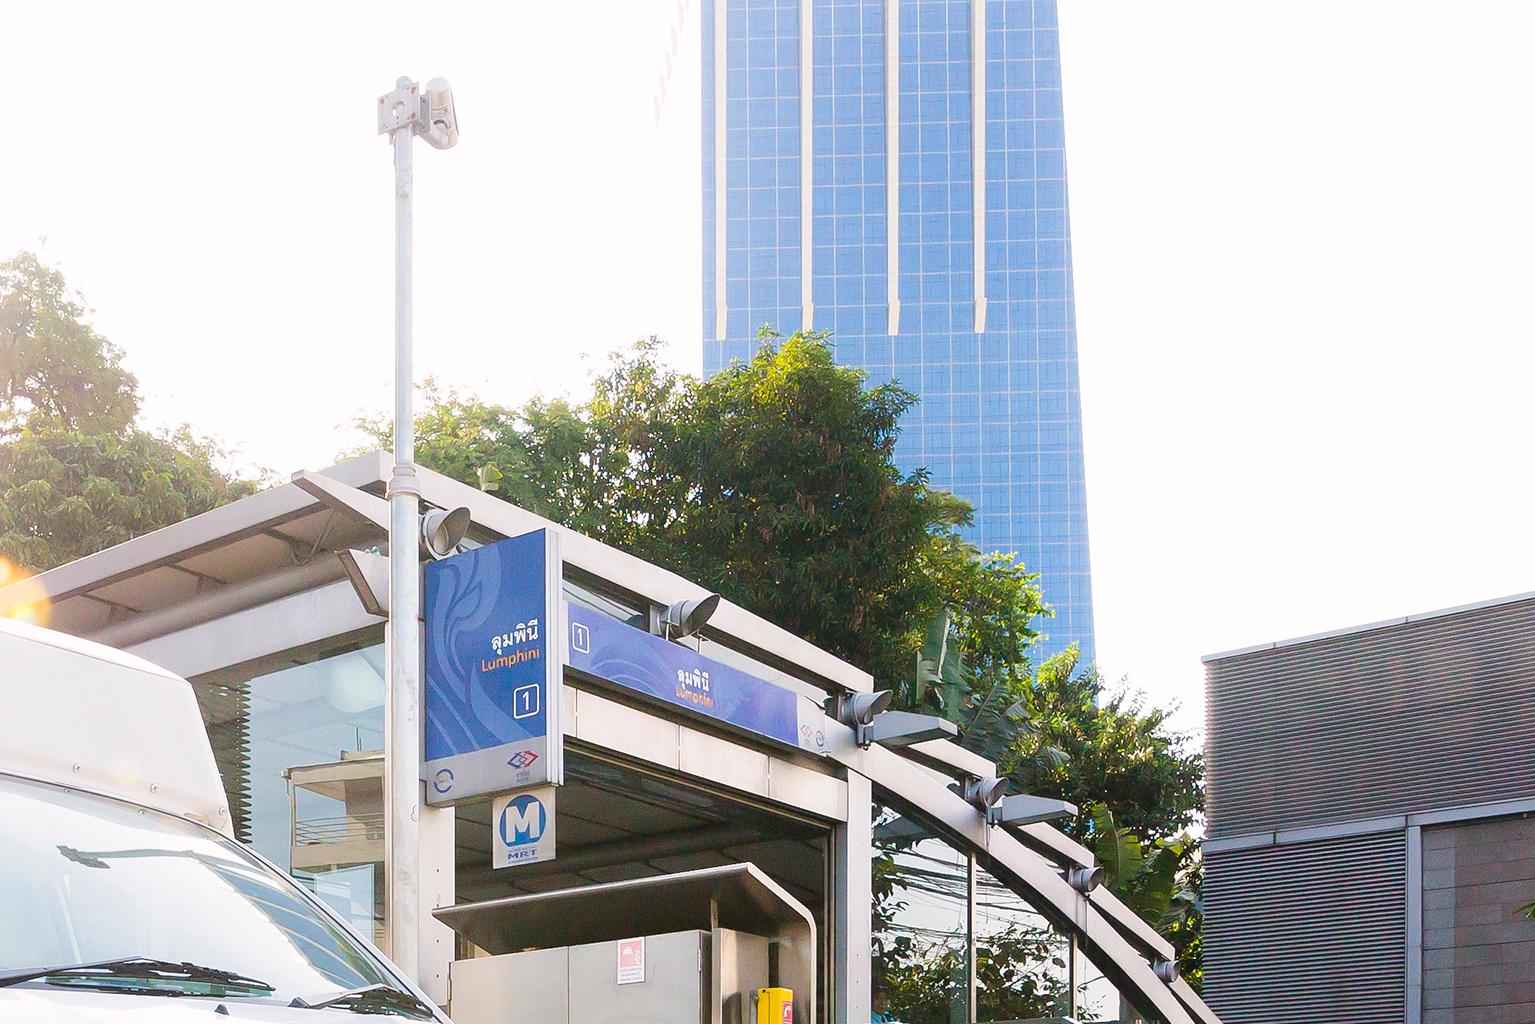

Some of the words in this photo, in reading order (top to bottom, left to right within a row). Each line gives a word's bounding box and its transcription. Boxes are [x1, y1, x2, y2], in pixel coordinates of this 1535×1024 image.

[491, 618, 539, 655] ลุมพินี
[577, 628, 583, 646] 1
[481, 648, 540, 672] Lumphini
[522, 691, 530, 711] 1
[507, 849, 538, 860] MRT
